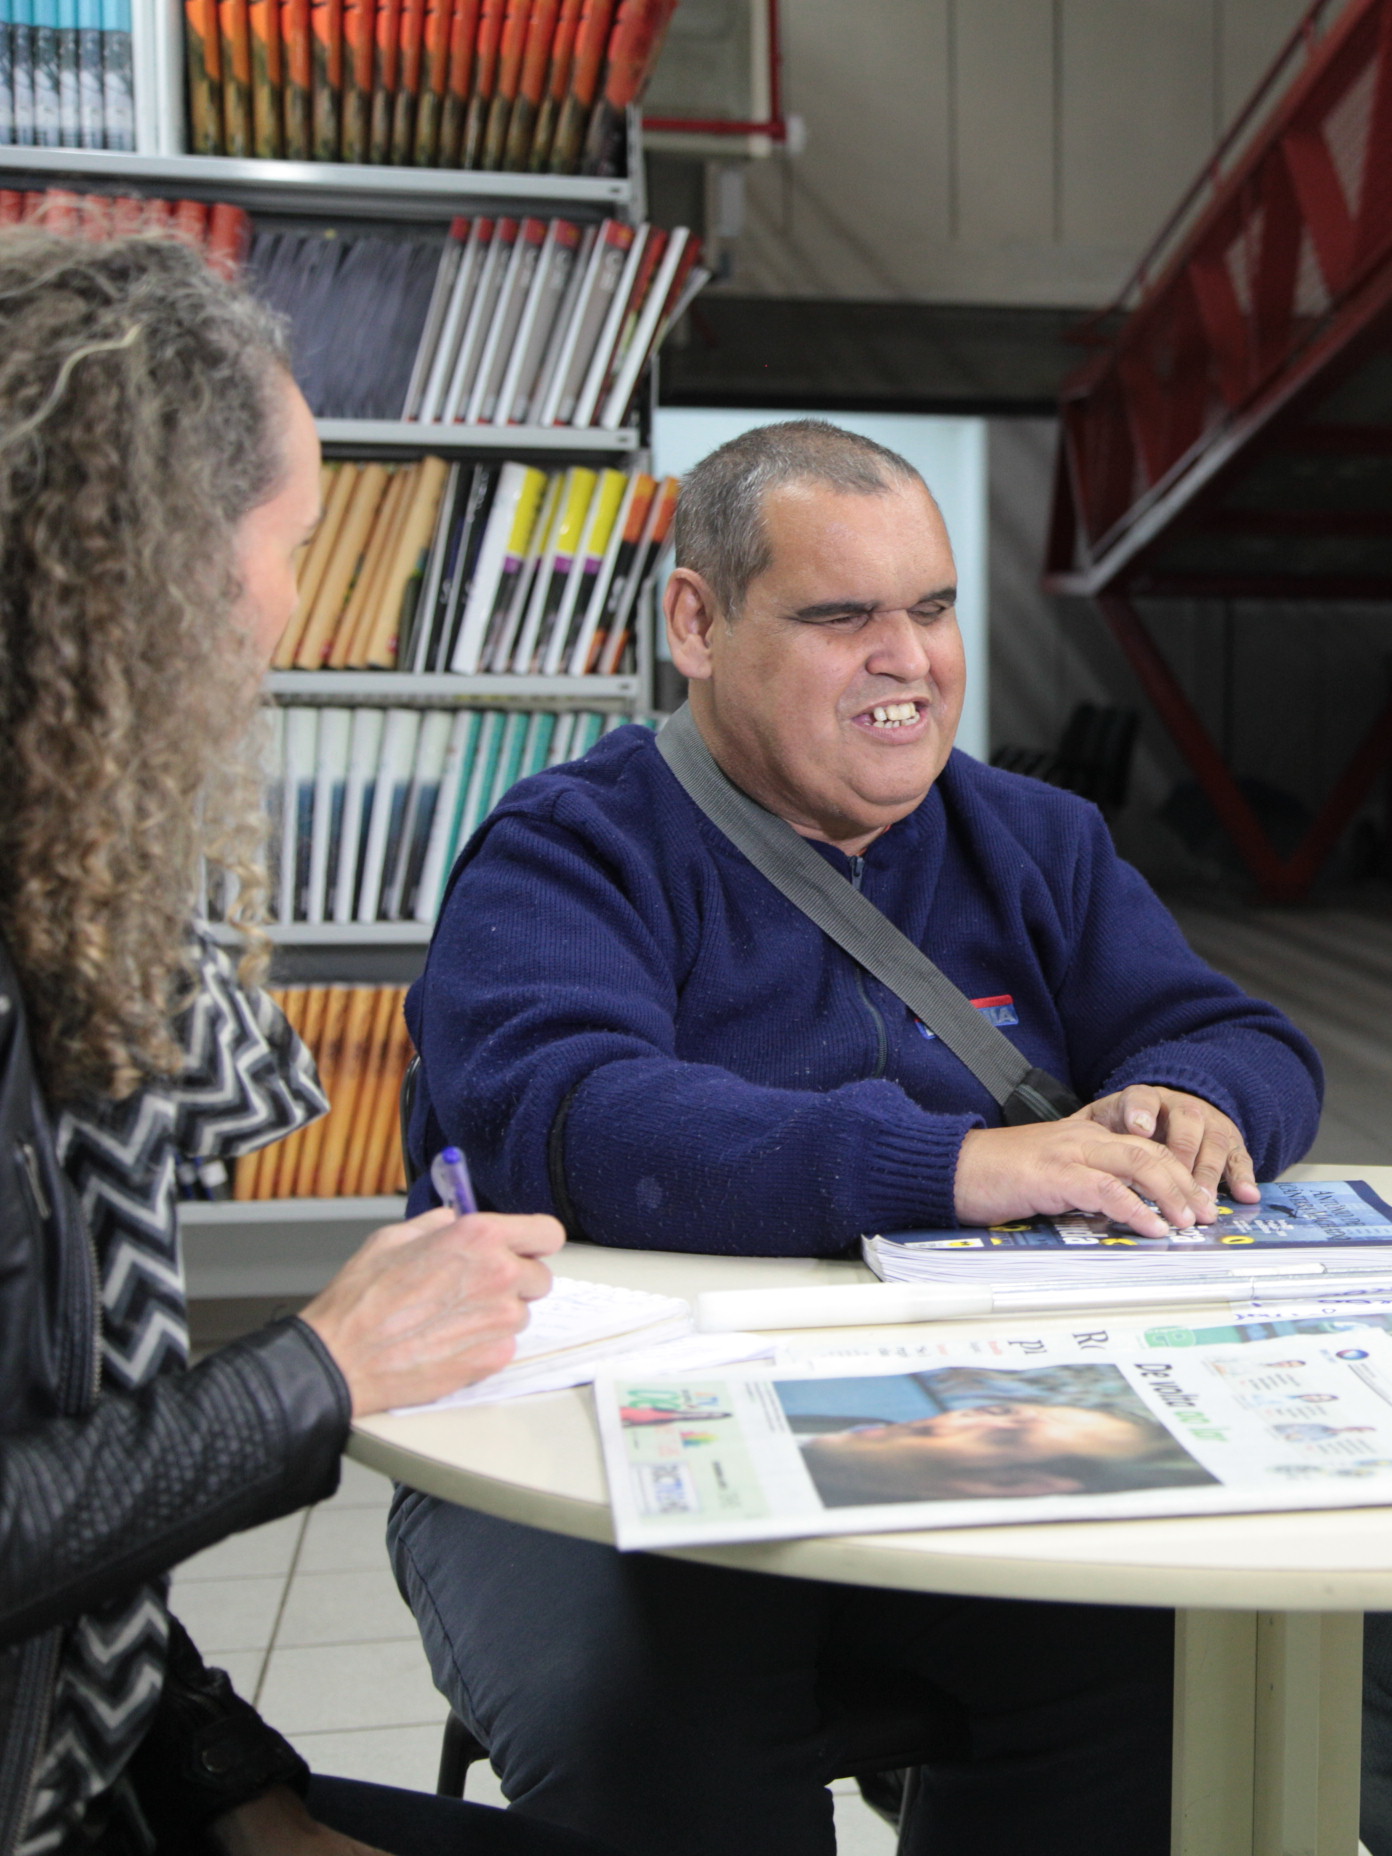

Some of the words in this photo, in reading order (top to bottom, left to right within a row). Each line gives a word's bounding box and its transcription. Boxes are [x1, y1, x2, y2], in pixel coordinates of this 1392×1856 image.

[1133, 1363, 1173, 1378] De
[1147, 1380, 1200, 1408] volta
[1173, 1411, 1212, 1425] ao
[1185, 1425, 1232, 1442] lar
